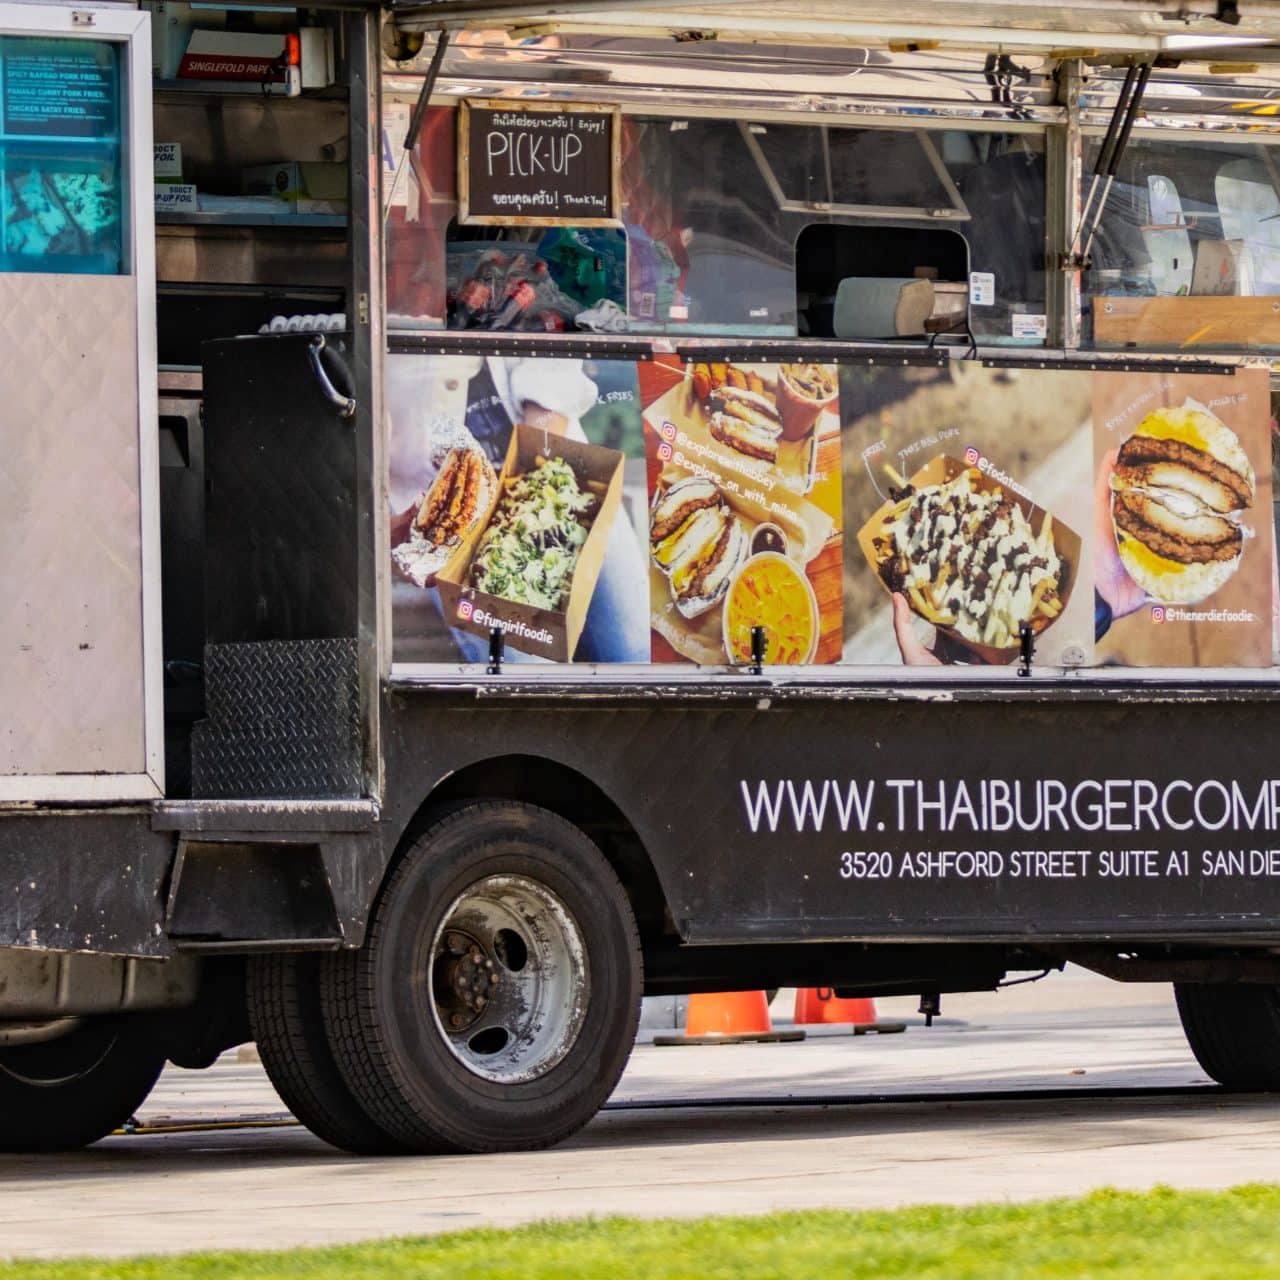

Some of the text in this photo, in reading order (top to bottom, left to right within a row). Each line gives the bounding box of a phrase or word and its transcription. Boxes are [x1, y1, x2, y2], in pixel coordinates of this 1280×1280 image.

[188, 61, 245, 73] SINGLEFOLD
[578, 120, 606, 134] Enjoy!
[487, 131, 583, 176] PICK-UP
[175, 195, 192, 203] FOIL
[1165, 607, 1253, 622] @thenerdiefoodie
[473, 609, 553, 644] @fungirlfoodie
[840, 851, 893, 878] 3520
[899, 851, 1004, 878] ASHFORD
[1010, 851, 1092, 878] STREET
[1098, 851, 1159, 877] SUITE
[1166, 850, 1189, 876] A1
[1202, 850, 1244, 876] SAN
